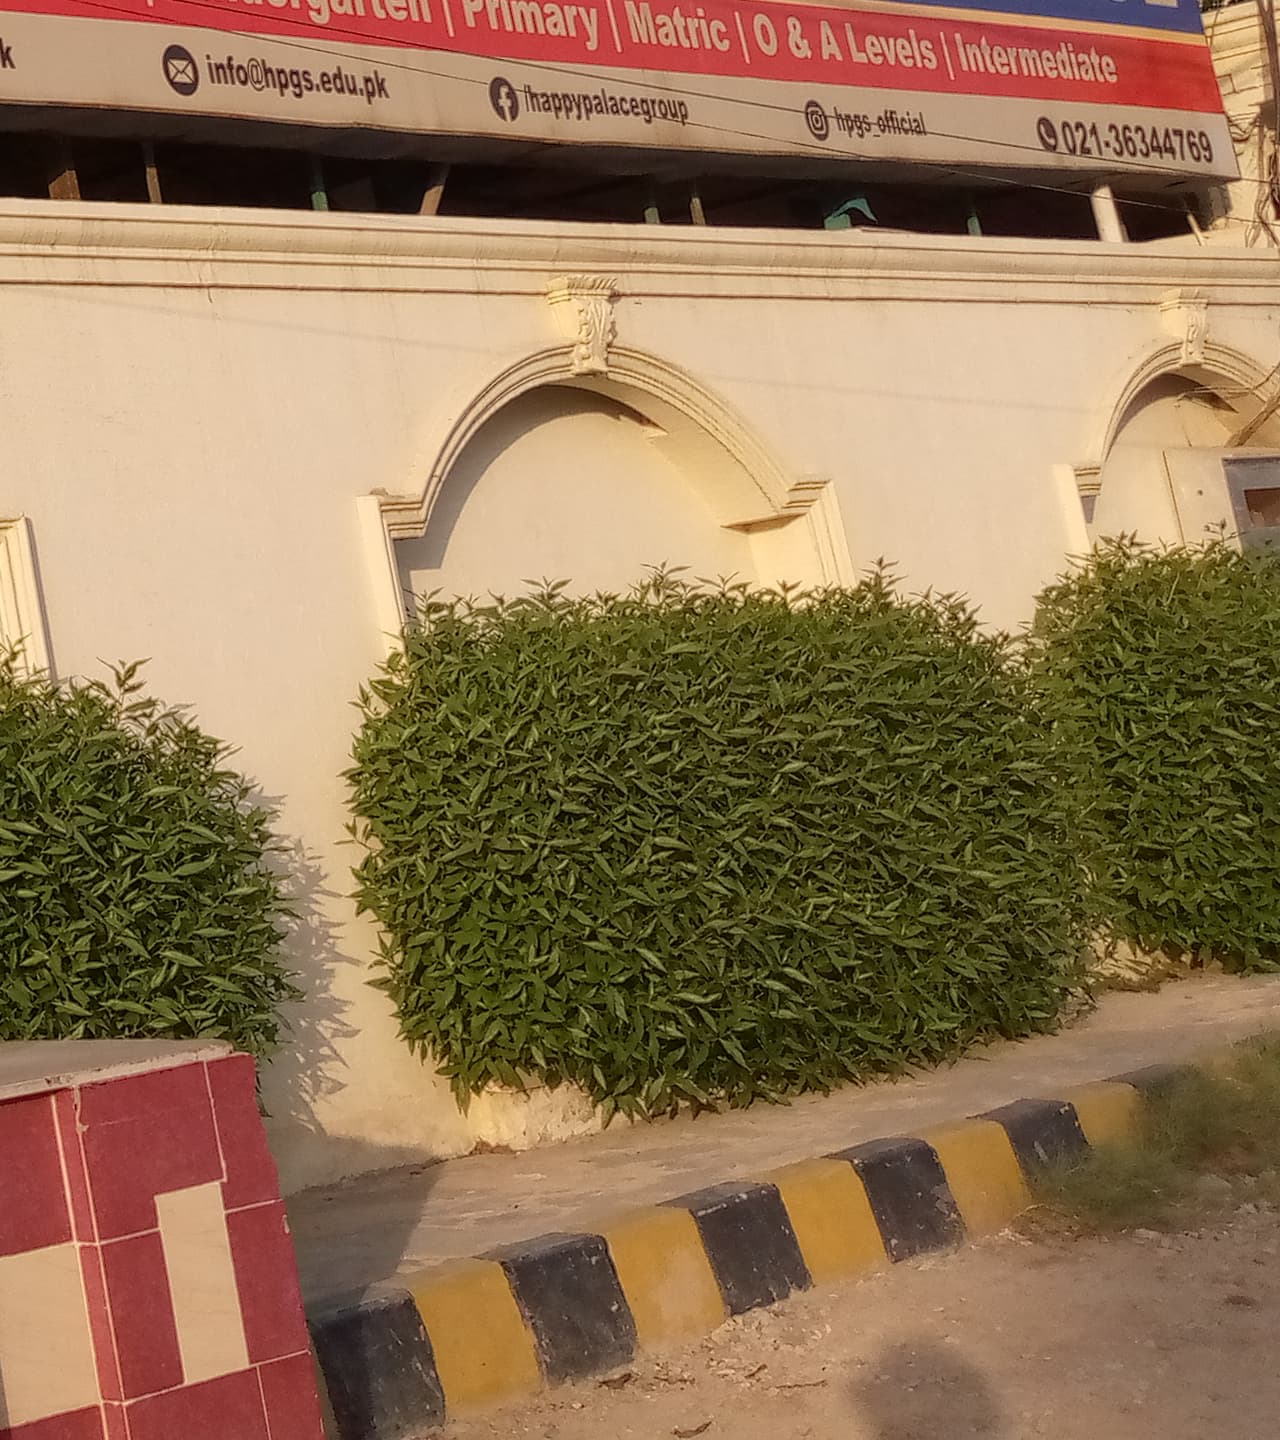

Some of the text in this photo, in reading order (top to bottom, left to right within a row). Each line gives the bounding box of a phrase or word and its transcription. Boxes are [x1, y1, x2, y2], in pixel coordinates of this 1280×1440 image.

[624, 0, 731, 52] Matric
[753, 13, 778, 56] O
[786, 16, 812, 60] &
[819, 20, 843, 61] A
[844, 22, 938, 70] Levels
[954, 32, 1119, 84] Intermediate
[205, 53, 391, 105] info@hpgs.edu.pk
[1060, 120, 1214, 163] 021-36344769
